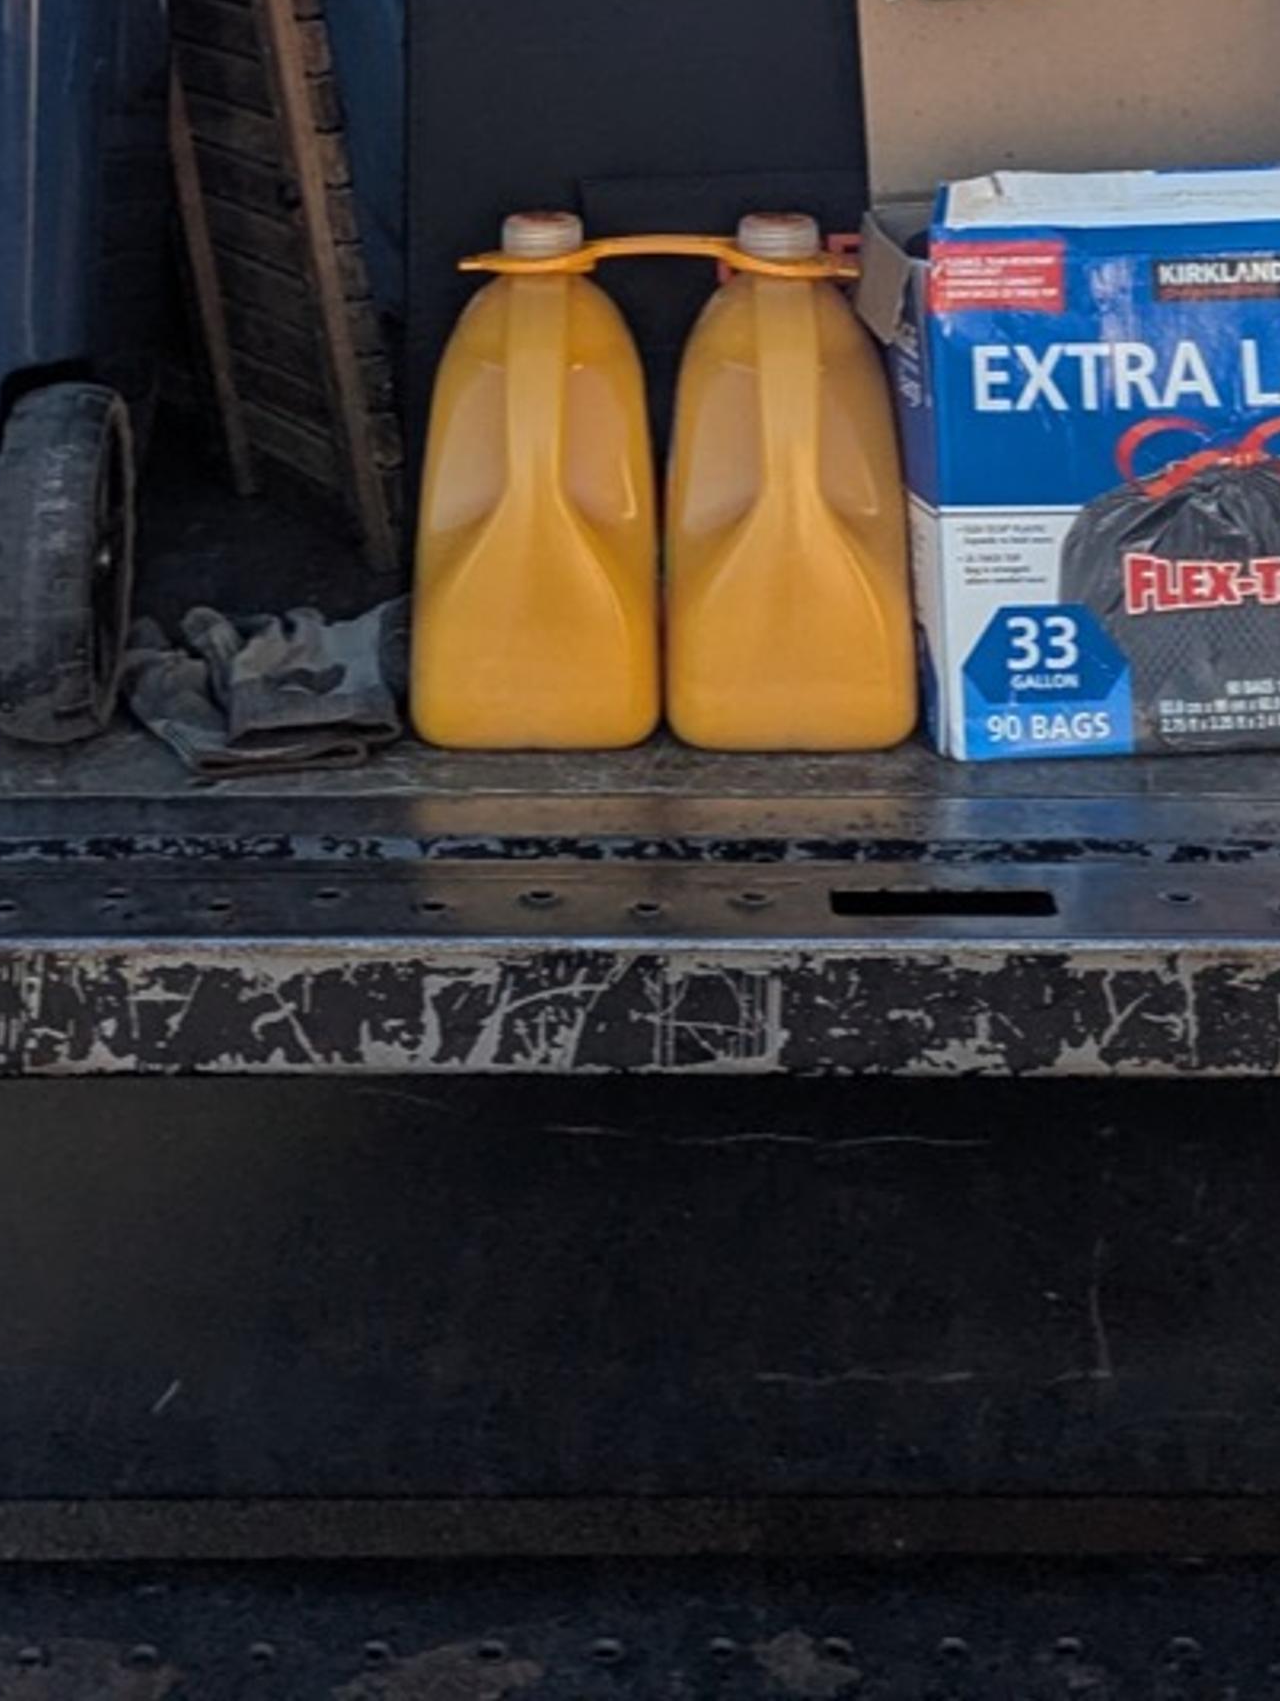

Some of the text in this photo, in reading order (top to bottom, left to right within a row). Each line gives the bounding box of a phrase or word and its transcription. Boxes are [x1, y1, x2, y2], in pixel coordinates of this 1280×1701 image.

[971, 341, 1221, 413] EXTRA
[1005, 614, 1080, 671] 33
[1009, 673, 1081, 690] GALLON
[985, 711, 1112, 742] 90 BAGS
